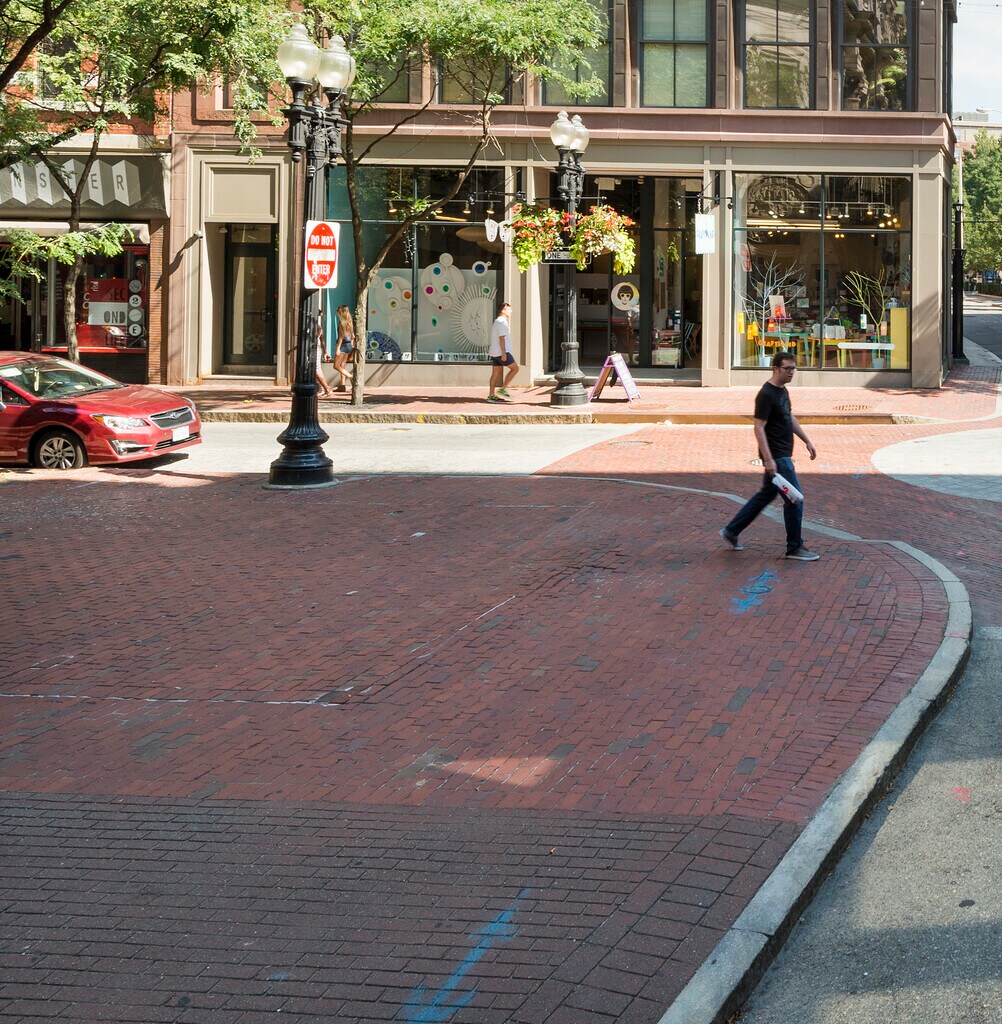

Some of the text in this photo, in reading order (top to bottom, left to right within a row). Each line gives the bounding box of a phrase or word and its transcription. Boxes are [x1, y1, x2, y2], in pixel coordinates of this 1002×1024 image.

[311, 235, 335, 247] DO NOT
[546, 252, 562, 260] ONE
[312, 264, 331, 275] ENTER
[103, 310, 126, 324] OND
